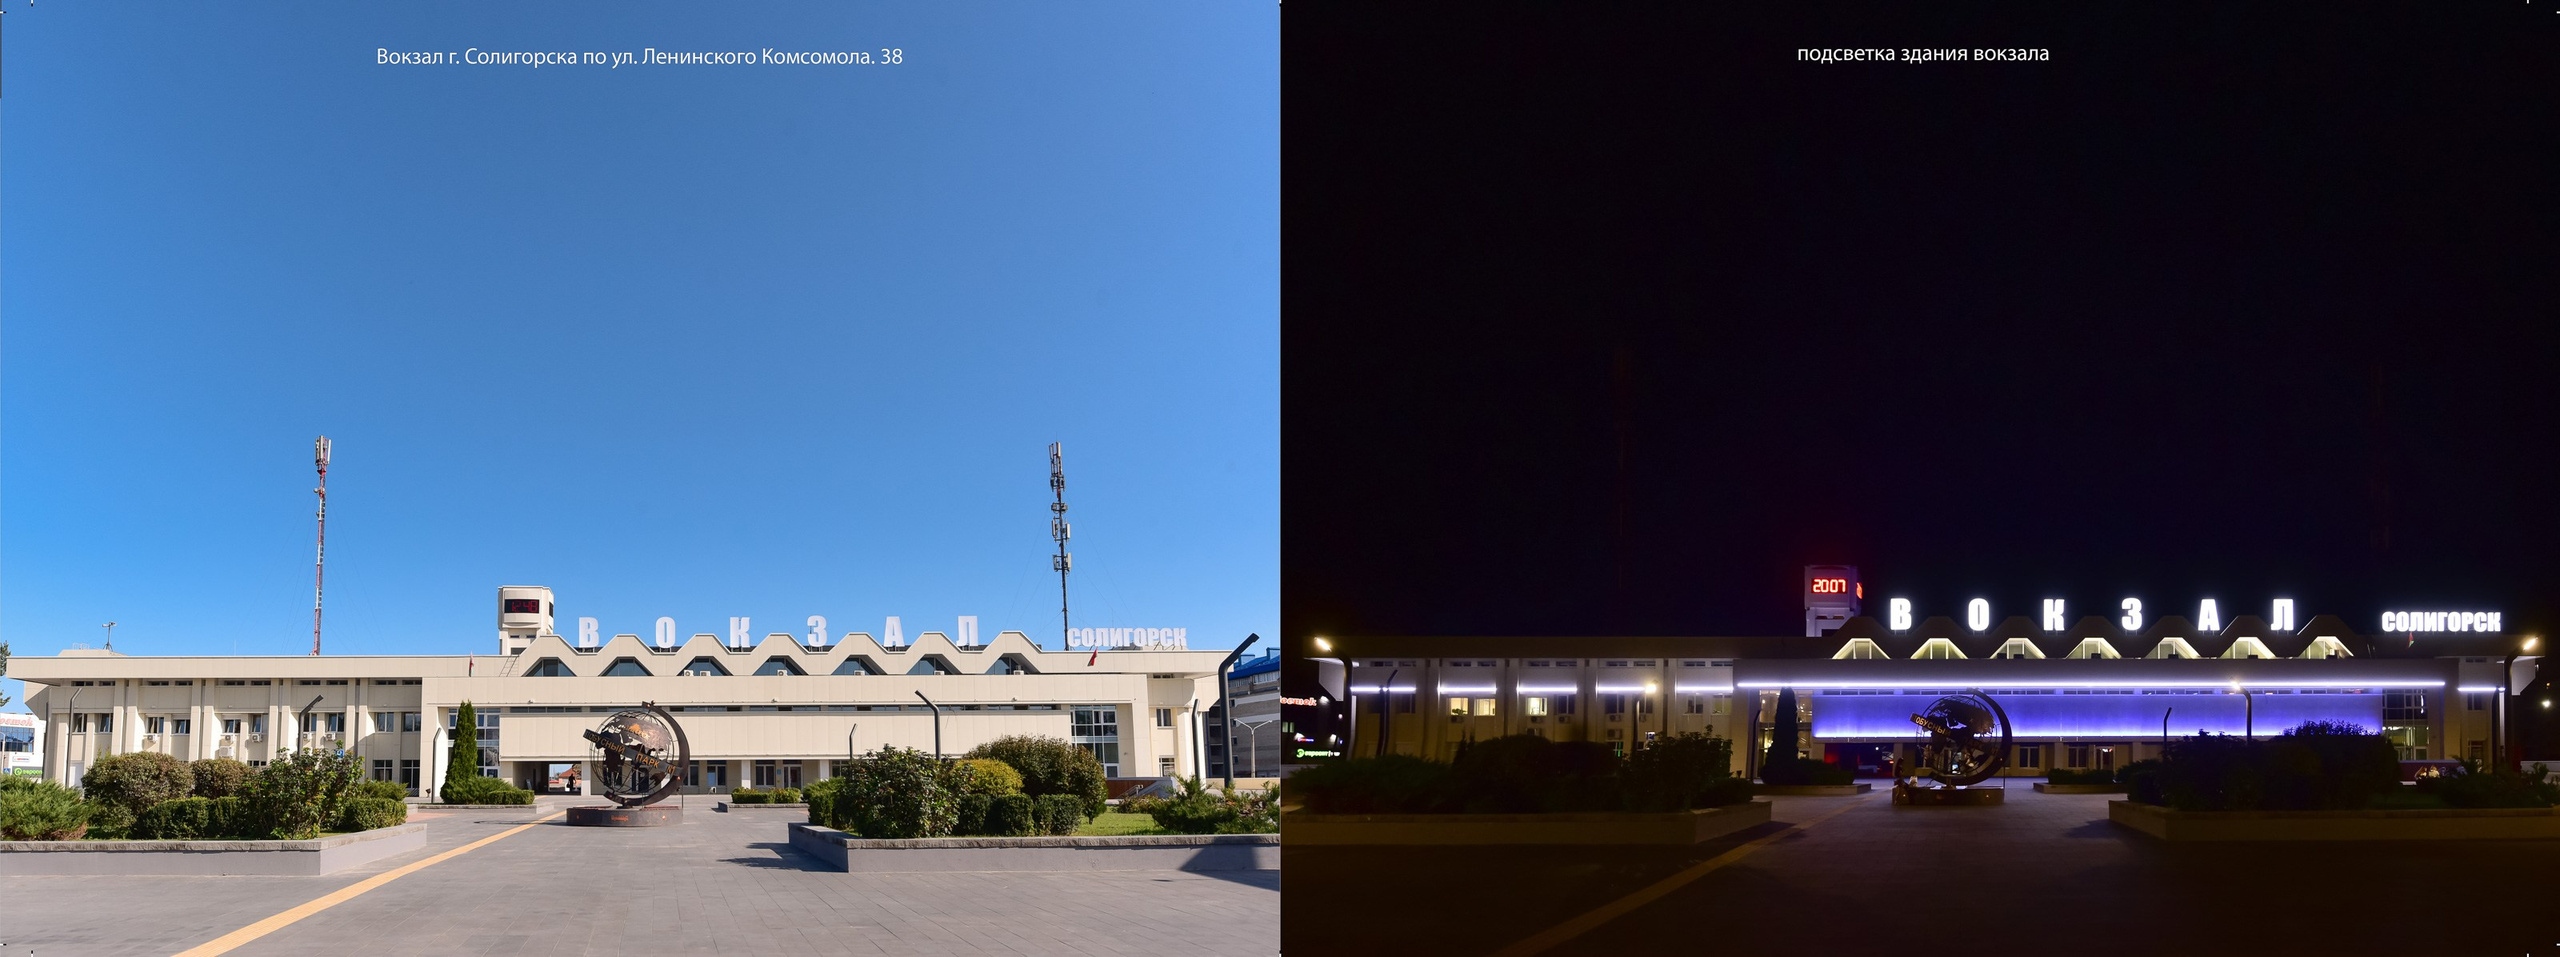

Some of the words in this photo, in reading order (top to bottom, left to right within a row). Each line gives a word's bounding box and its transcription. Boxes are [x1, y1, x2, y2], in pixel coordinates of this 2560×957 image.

[1812, 579, 1846, 593] 2007
[2381, 611, 2501, 632] СОЛИГОРСК
[1067, 627, 1187, 647] СОЛИГОРСК
[636, 753, 660, 768] ПАРК
